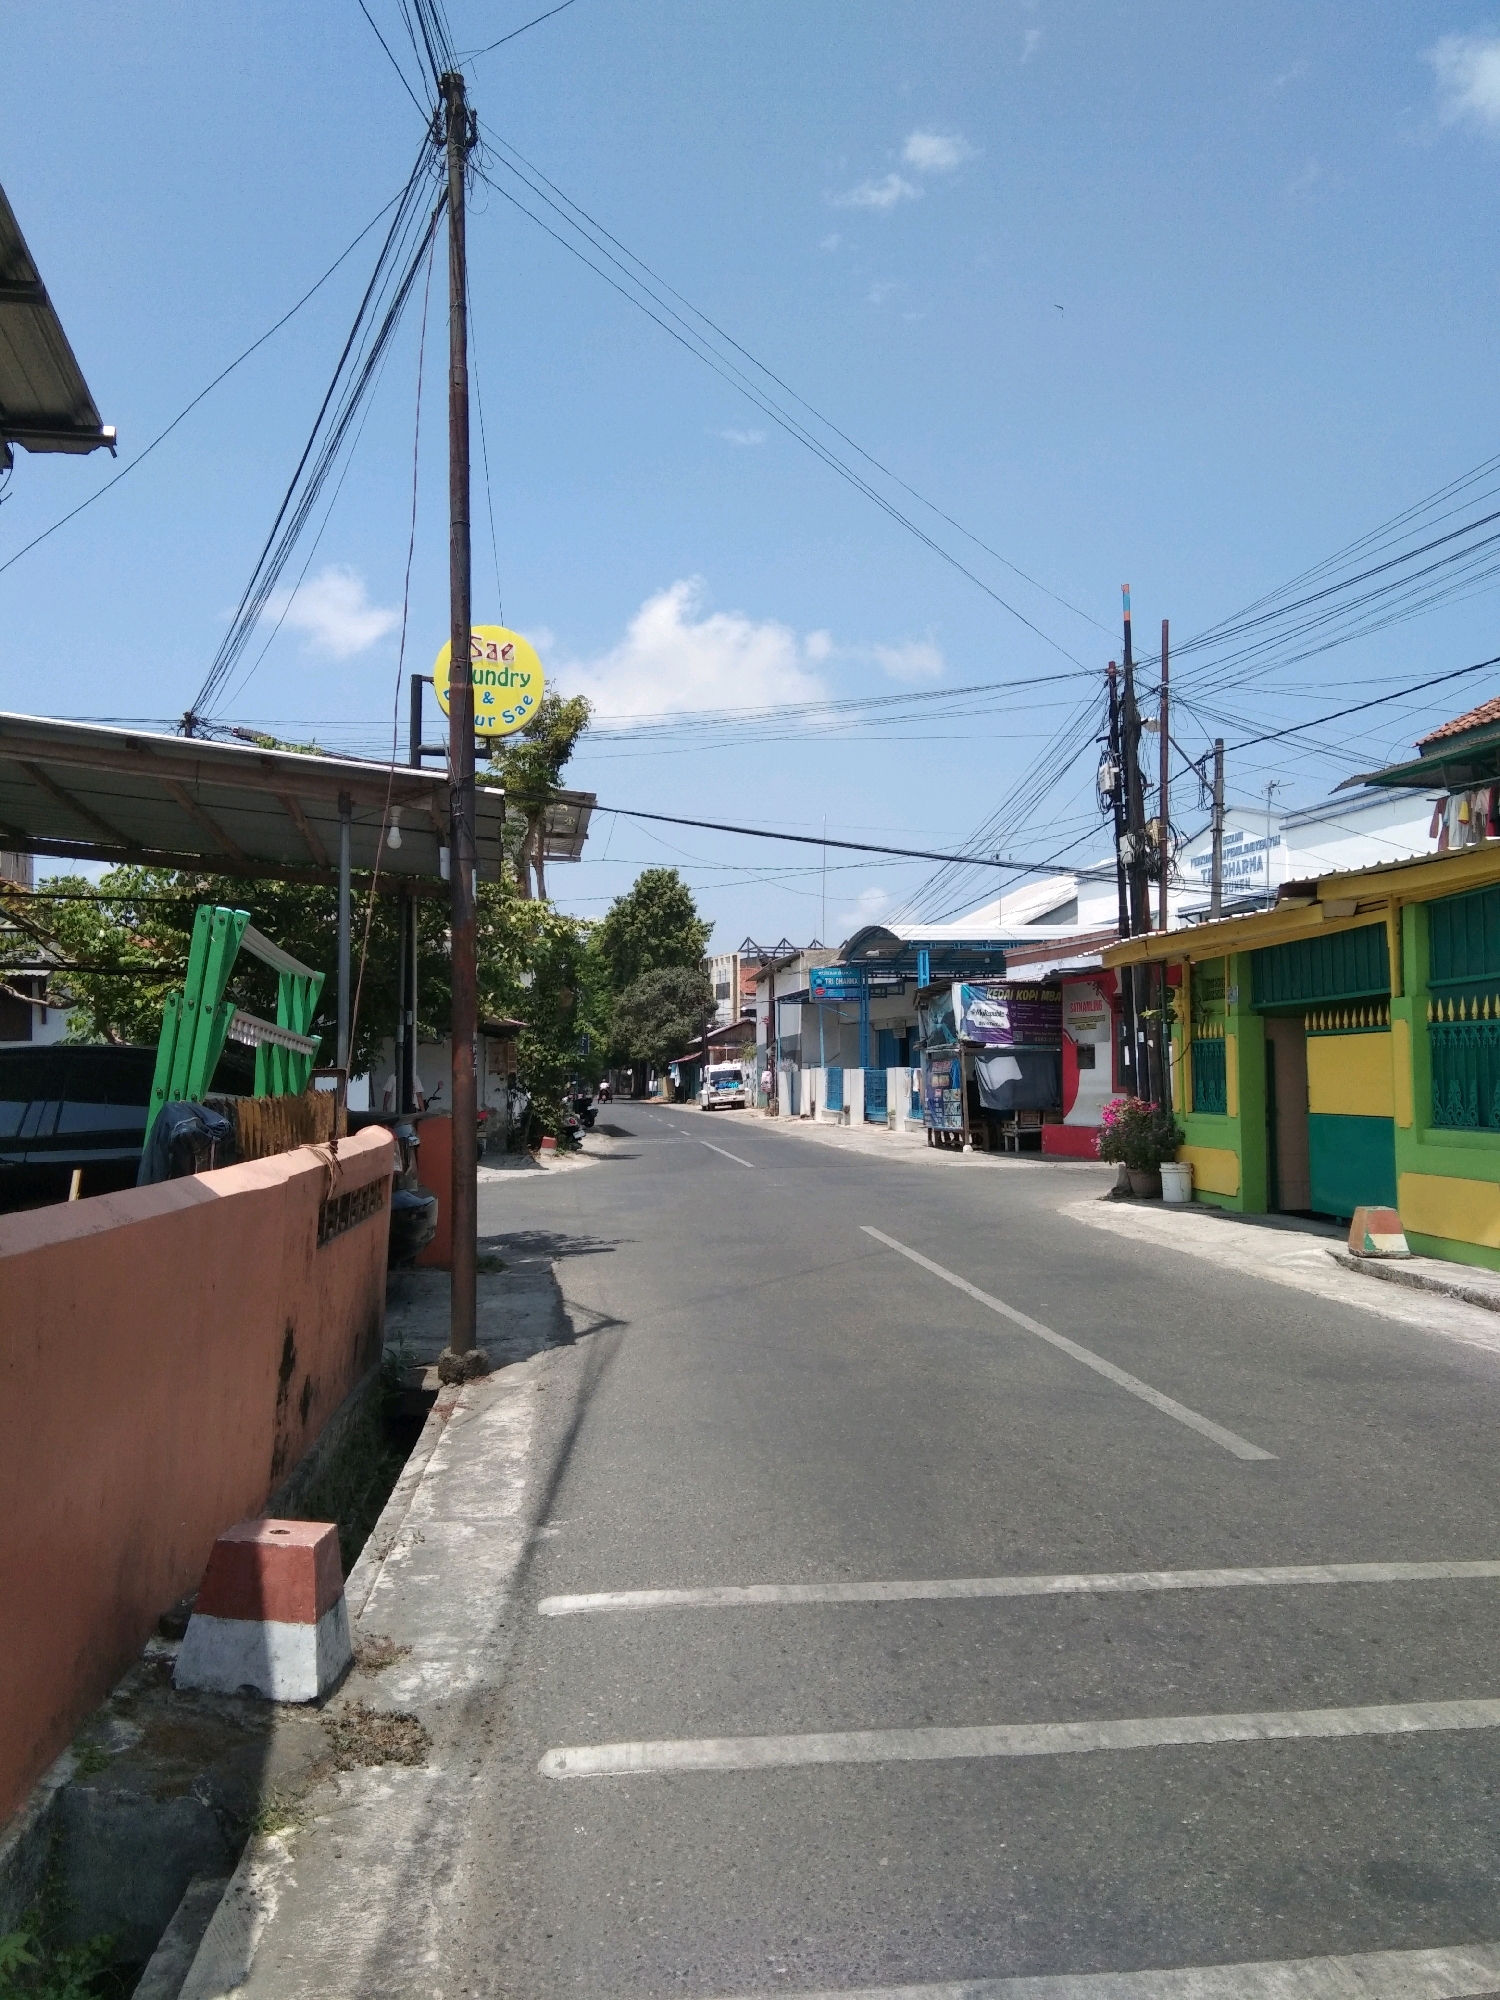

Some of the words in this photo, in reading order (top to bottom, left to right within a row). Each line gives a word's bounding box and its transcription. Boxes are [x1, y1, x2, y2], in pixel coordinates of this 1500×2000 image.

[470, 635, 515, 662] Sae
[448, 667, 531, 688] undry
[482, 691, 495, 705] &
[502, 695, 534, 724] Sae
[1222, 855, 1264, 878] DHARMA
[987, 988, 1014, 1001] KEDAI
[1016, 989, 1039, 1001] KOPI
